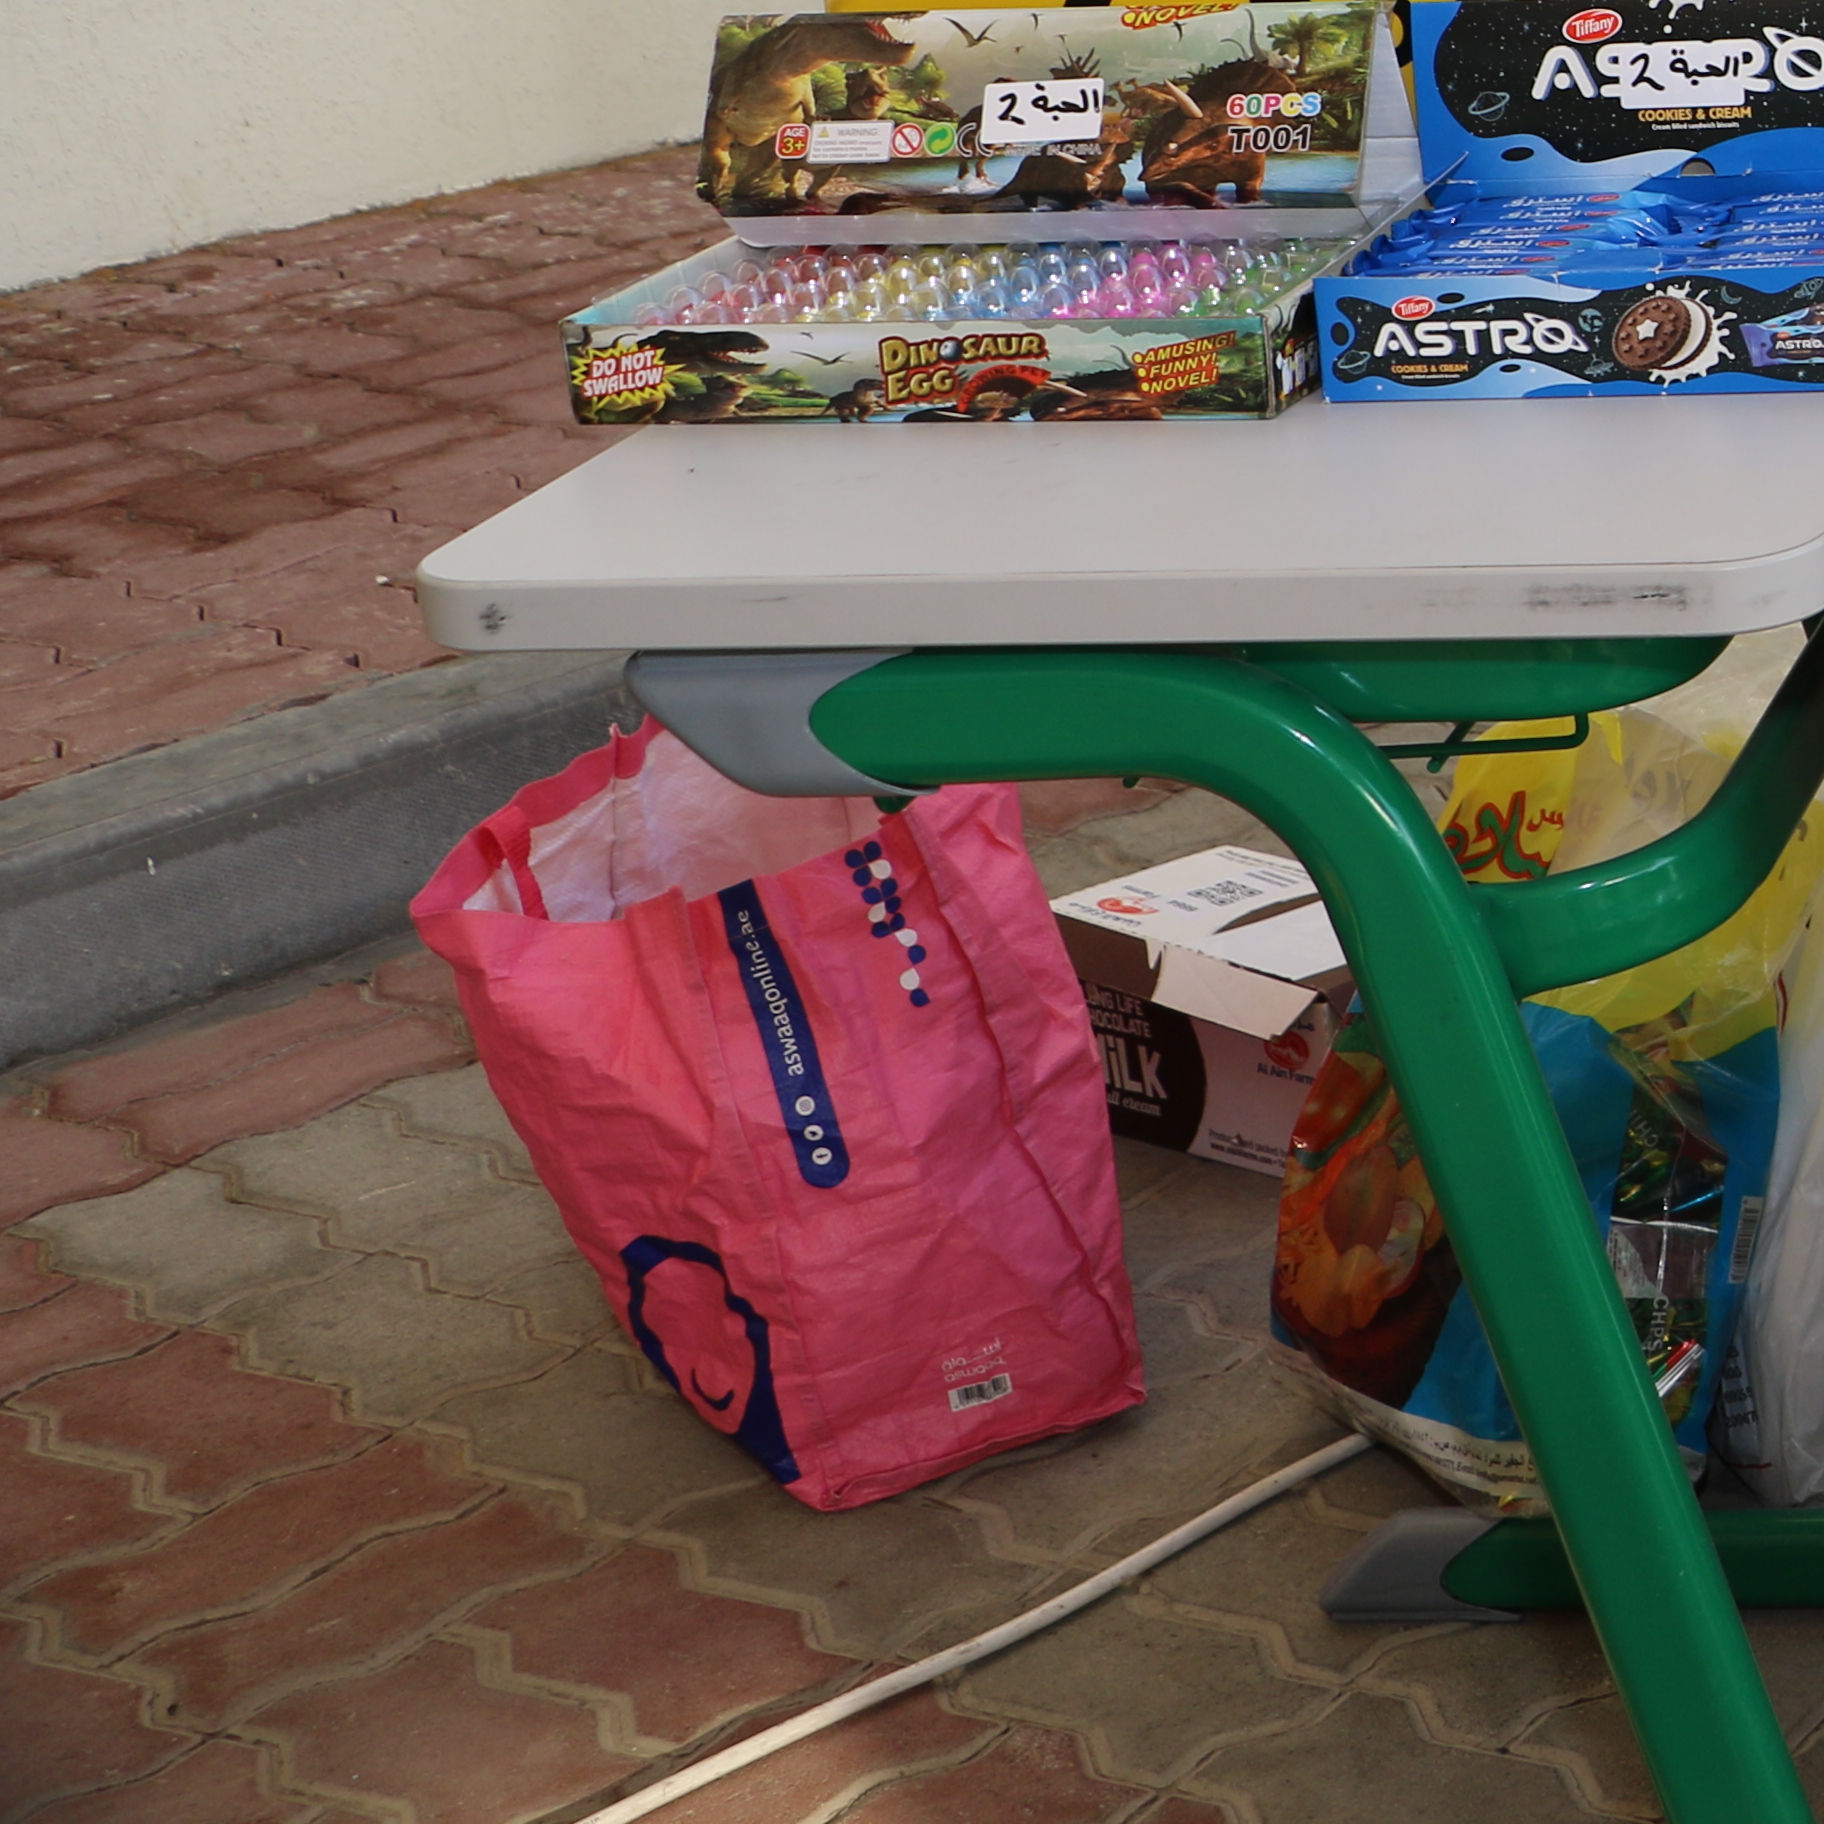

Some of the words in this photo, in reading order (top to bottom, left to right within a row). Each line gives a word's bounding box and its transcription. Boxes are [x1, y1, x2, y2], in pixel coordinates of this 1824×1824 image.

[1571, 14, 1615, 39] Tiffany
[1631, 53, 1665, 91] 2
[997, 93, 1026, 125] 2
[1226, 92, 1323, 117] 60PCS
[1638, 108, 1693, 122] COOKIES
[1695, 108, 1706, 120] &
[1708, 106, 1752, 120] CREAM
[783, 126, 806, 138] AGE
[1229, 125, 1312, 152] T001
[781, 137, 806, 155] 3+
[1398, 298, 1430, 318] Tiffany
[1144, 333, 1235, 364] AMUSING!
[1373, 312, 1590, 359] ASTRO
[1775, 338, 1824, 351] ASTRO
[592, 356, 617, 379] DO
[621, 349, 655, 370] NOT
[881, 335, 1046, 373] DINOSAUR
[1150, 352, 1217, 379] FUNNY!
[1151, 368, 1218, 395] NOVEL!
[1391, 364, 1428, 374] COOKIES
[1439, 363, 1469, 373] CREAM
[584, 367, 665, 399] SWALLOW
[886, 370, 954, 404] EGG
[737, 909, 805, 1077] aswaaqonline.ae
[1115, 996, 1145, 1016] LIFE
[1122, 1098, 1162, 1117] cream
